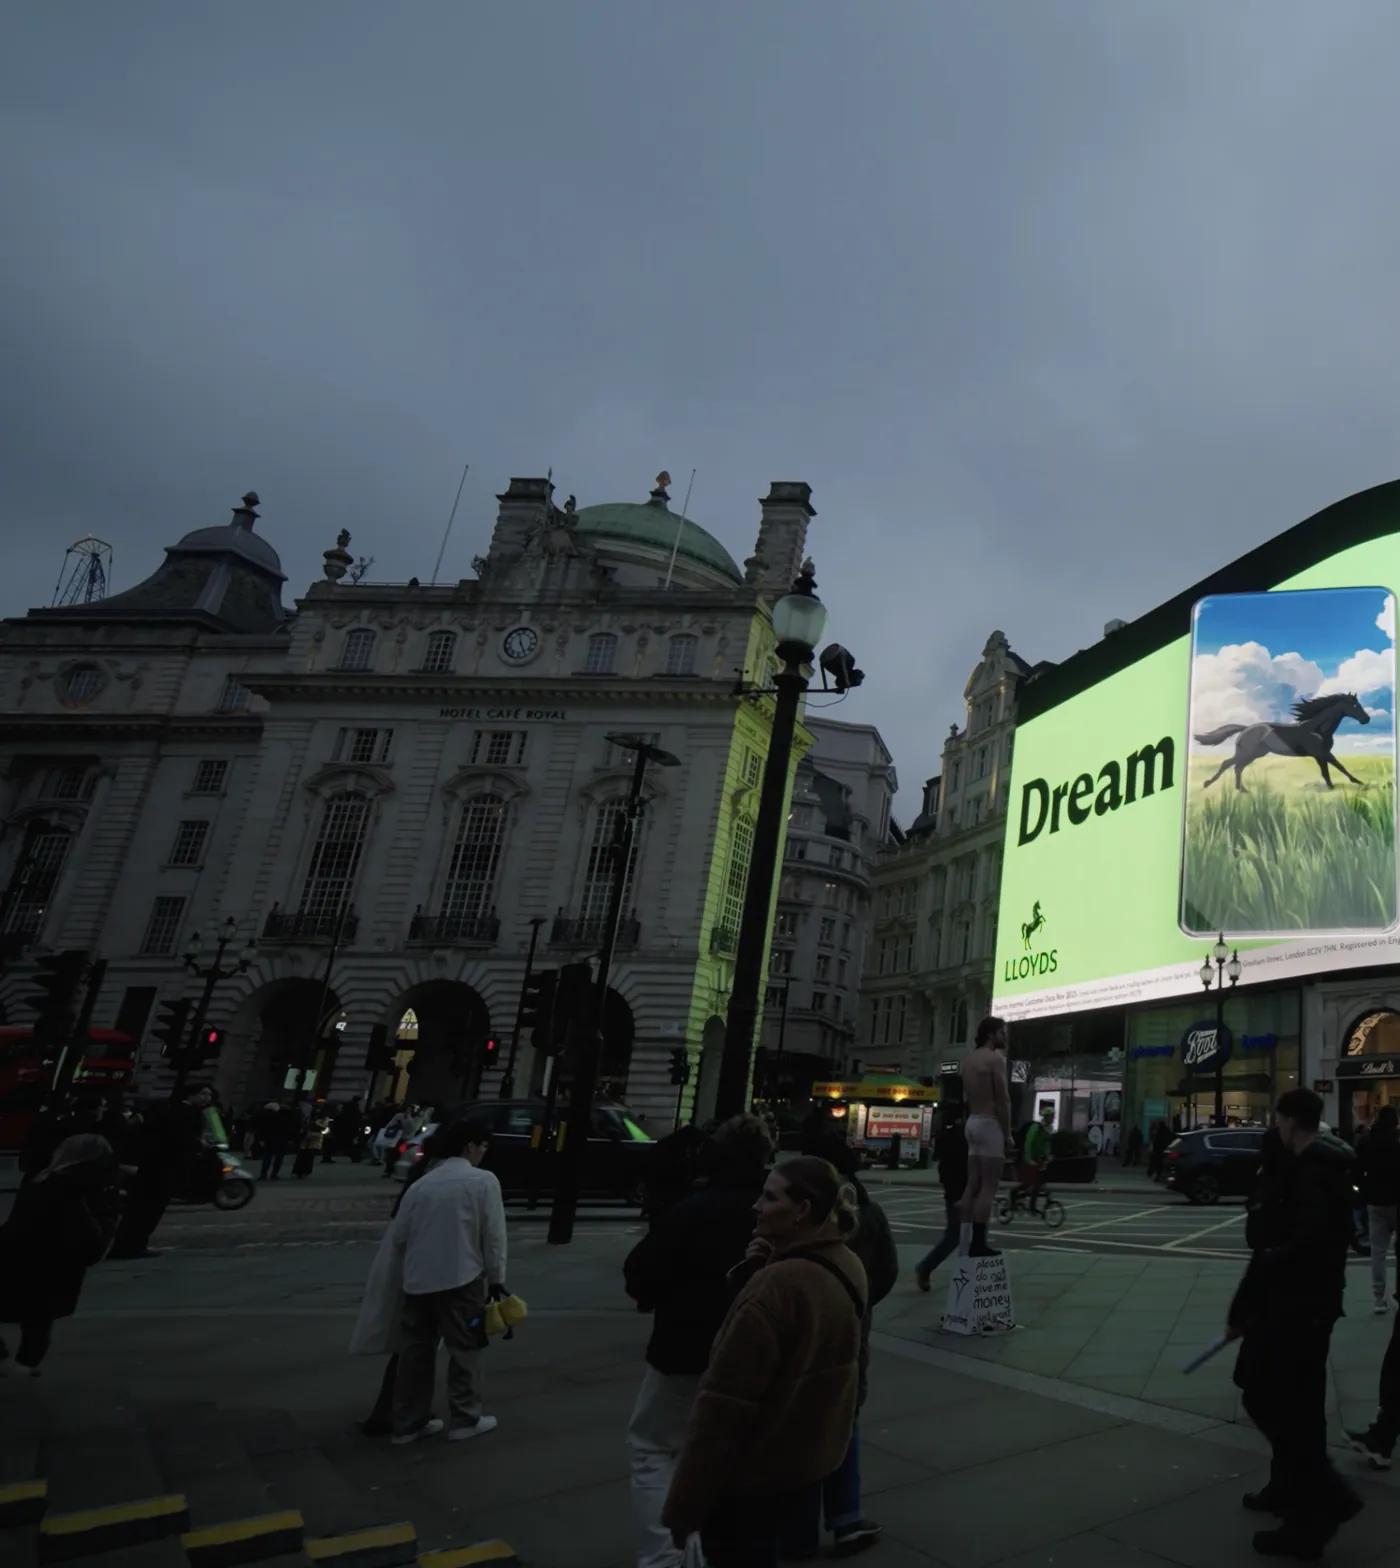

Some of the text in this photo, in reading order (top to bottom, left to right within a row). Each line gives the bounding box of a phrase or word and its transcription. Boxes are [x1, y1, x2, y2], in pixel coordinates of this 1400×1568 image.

[440, 708, 567, 720] HOTEL CAFÉ ROYAL
[1018, 736, 1175, 847] Dream
[1285, 951, 1306, 960] London
[1340, 938, 1377, 951] Registered
[1379, 937, 1386, 946] in
[1004, 949, 1058, 982] LLOYDS
[1184, 1028, 1221, 1065] Boot
[976, 1258, 1004, 1271] please
[976, 1269, 988, 1281] do
[974, 1282, 1008, 1297] give me
[973, 1295, 1011, 1309] money
